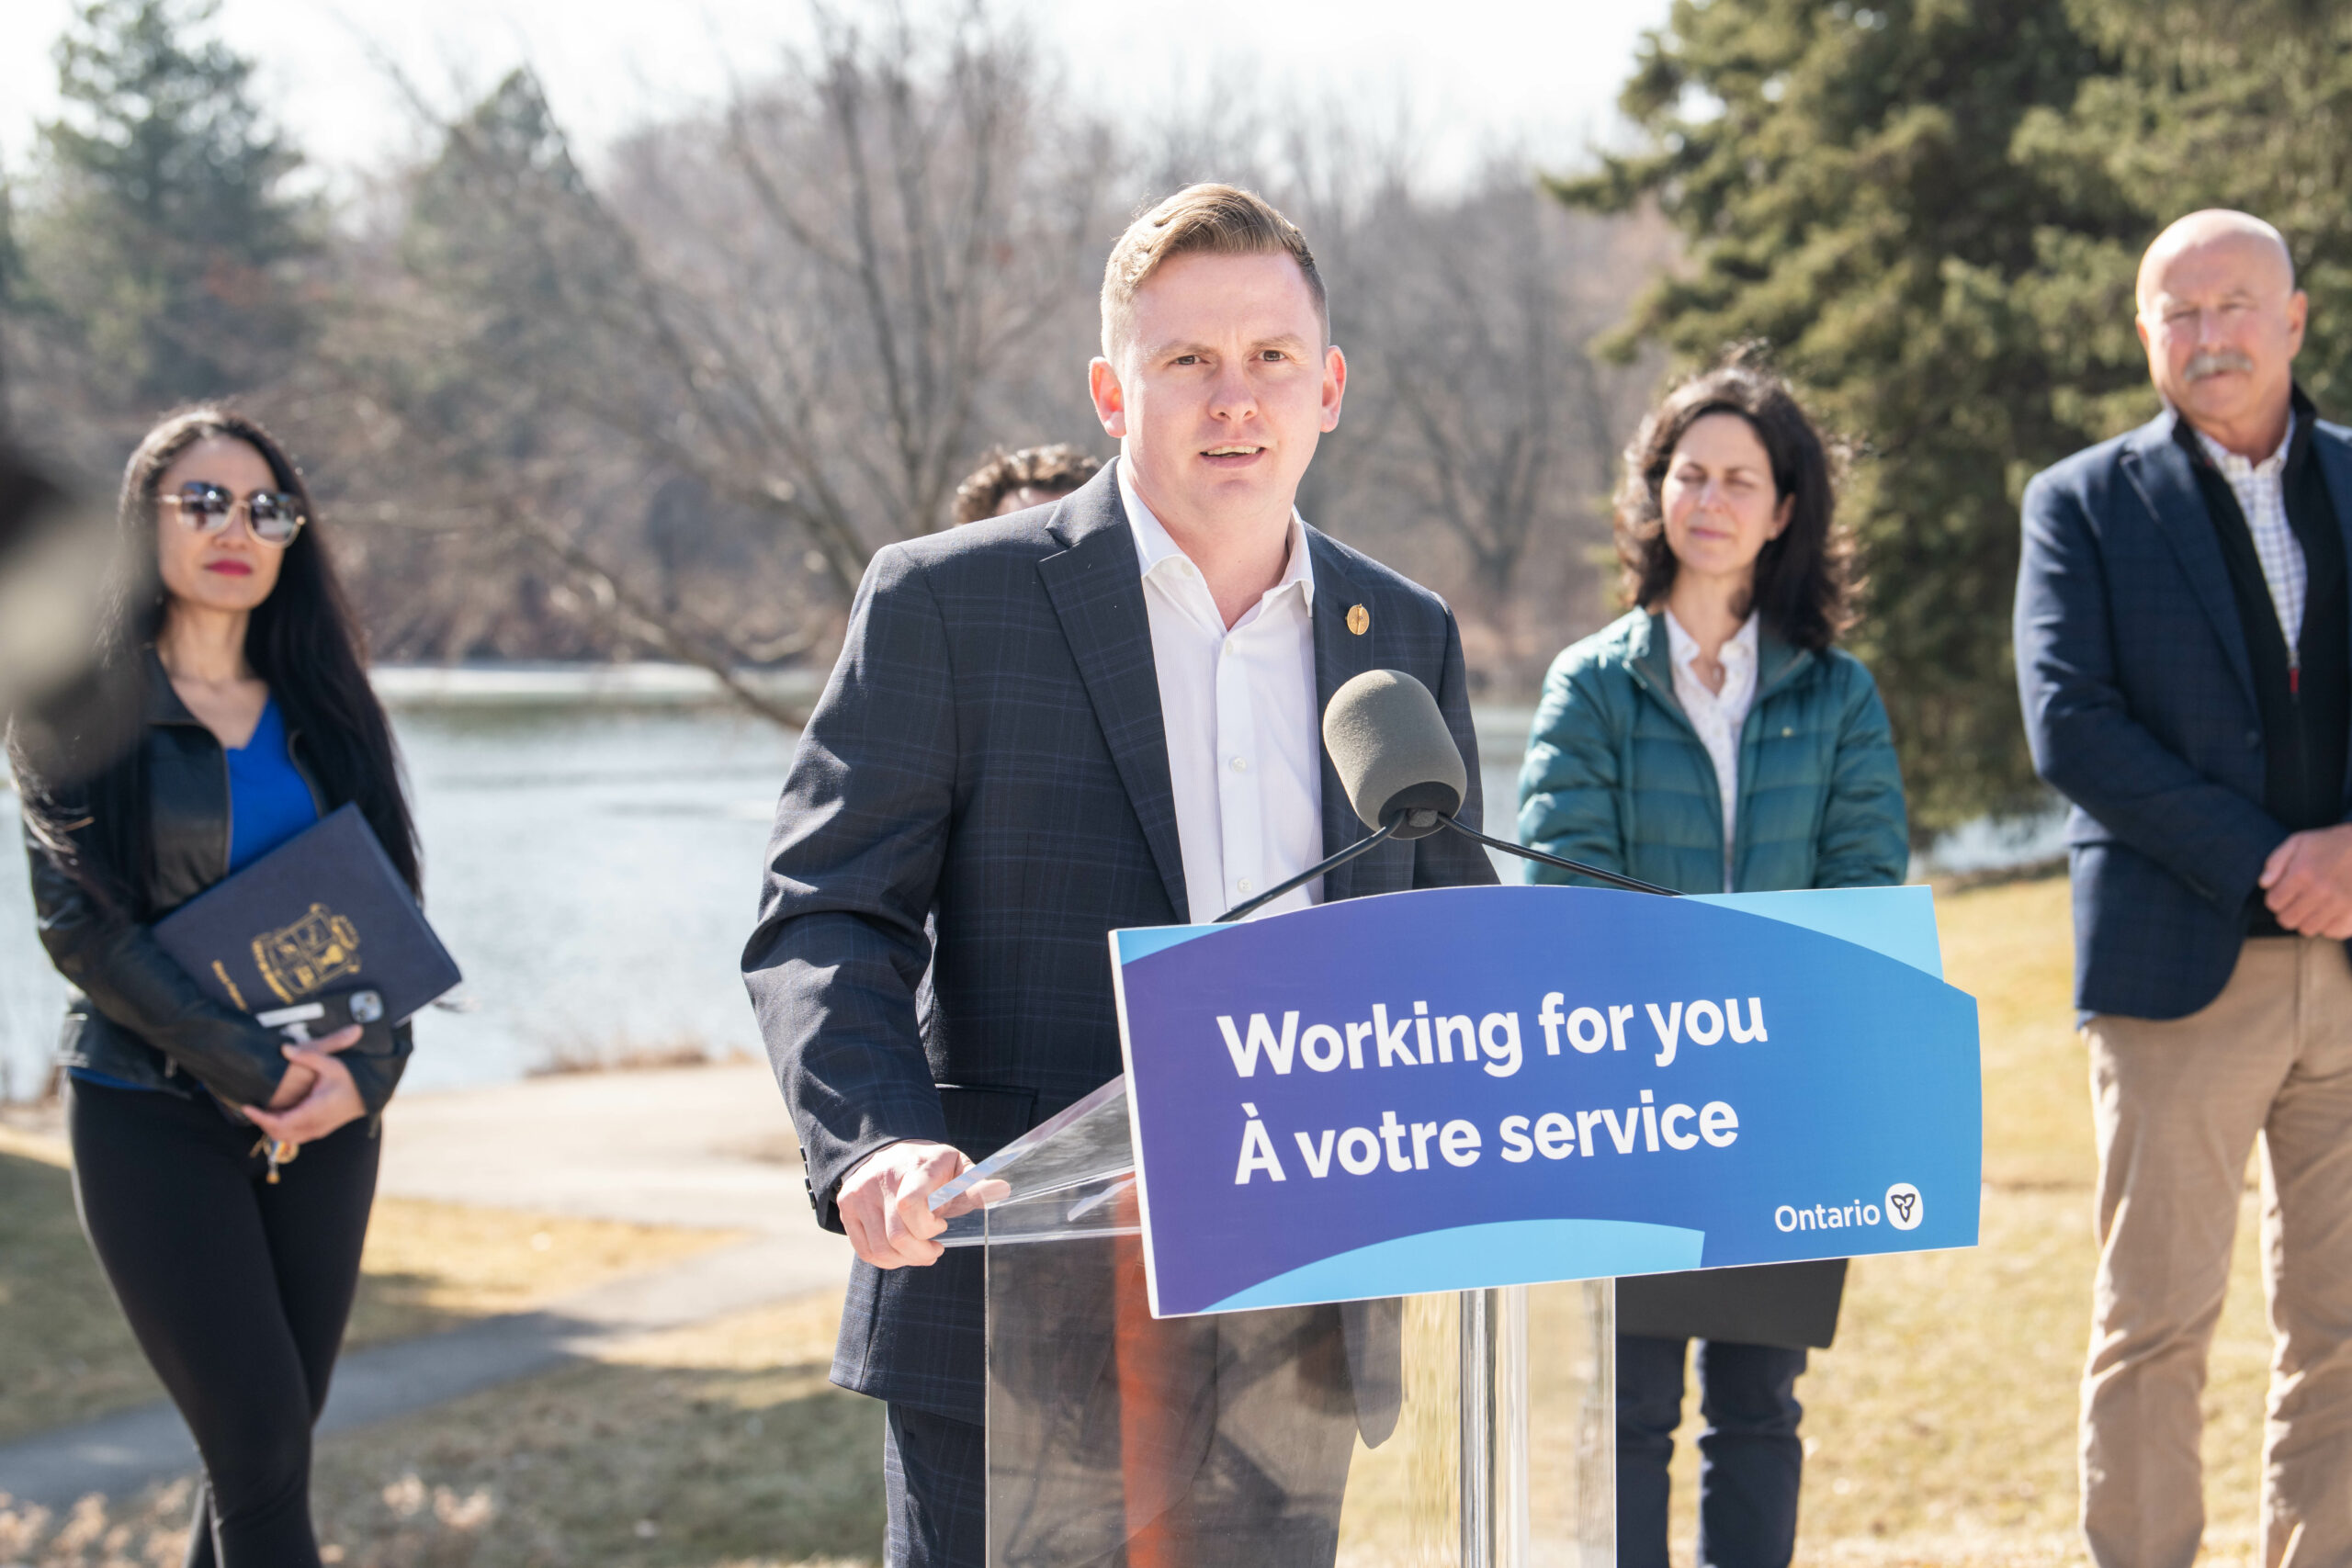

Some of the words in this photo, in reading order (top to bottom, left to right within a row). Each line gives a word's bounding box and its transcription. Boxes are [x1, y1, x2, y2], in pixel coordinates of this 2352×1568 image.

[1216, 1000, 1523, 1077] Working
[1538, 991, 1634, 1055] for
[1645, 997, 1768, 1067] you
[1235, 1102, 1286, 1185] À
[1294, 1108, 1482, 1179] votre
[1499, 1089, 1739, 1163] service
[1775, 1203, 1881, 1233] Ontario
